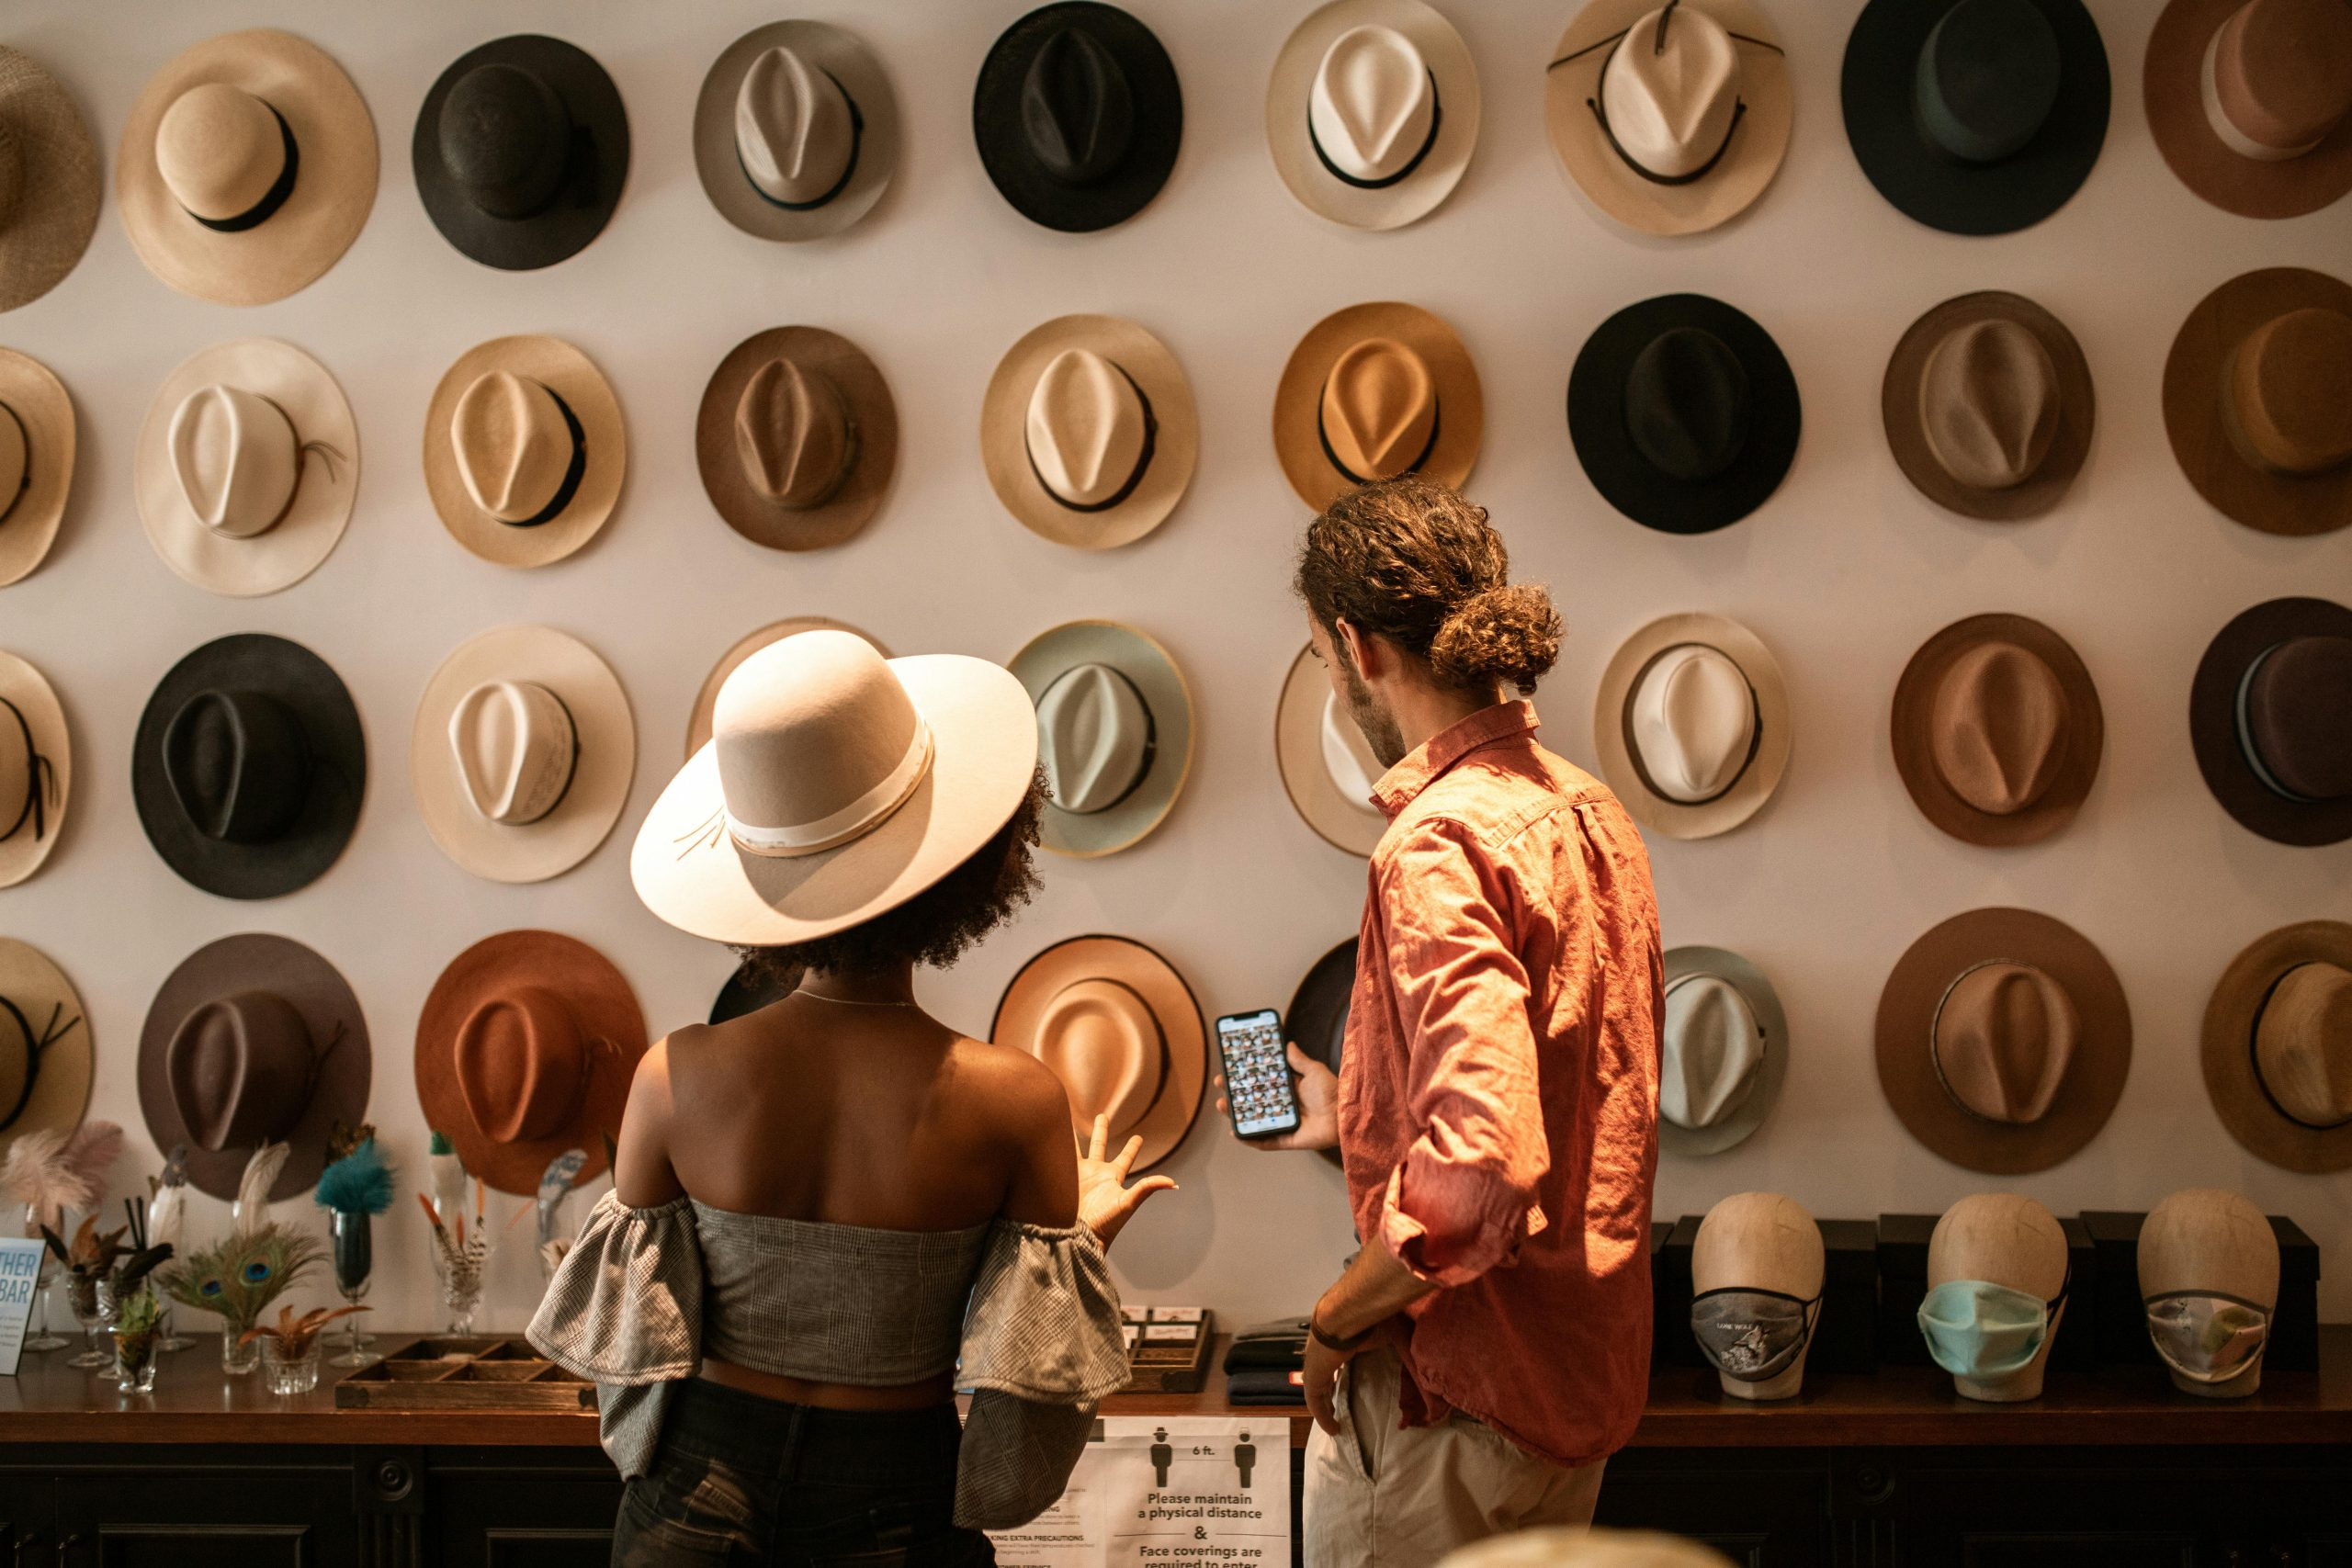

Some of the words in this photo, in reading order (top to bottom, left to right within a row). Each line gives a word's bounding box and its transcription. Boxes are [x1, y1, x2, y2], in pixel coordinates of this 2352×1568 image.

[0, 1278, 31, 1303] BAR
[1192, 1446, 1201, 1456] 6
[1203, 1446, 1216, 1456] ft.
[1148, 1493, 1191, 1505] Please
[1194, 1493, 1252, 1505] maintain
[1137, 1509, 1147, 1519] a
[1148, 1506, 1204, 1521] physical
[1206, 1506, 1262, 1519] distance
[1193, 1525, 1208, 1540] &
[1139, 1546, 1170, 1557] Face
[1173, 1545, 1238, 1560] coverings
[1241, 1548, 1262, 1558] are
[1145, 1560, 1202, 1568] required
